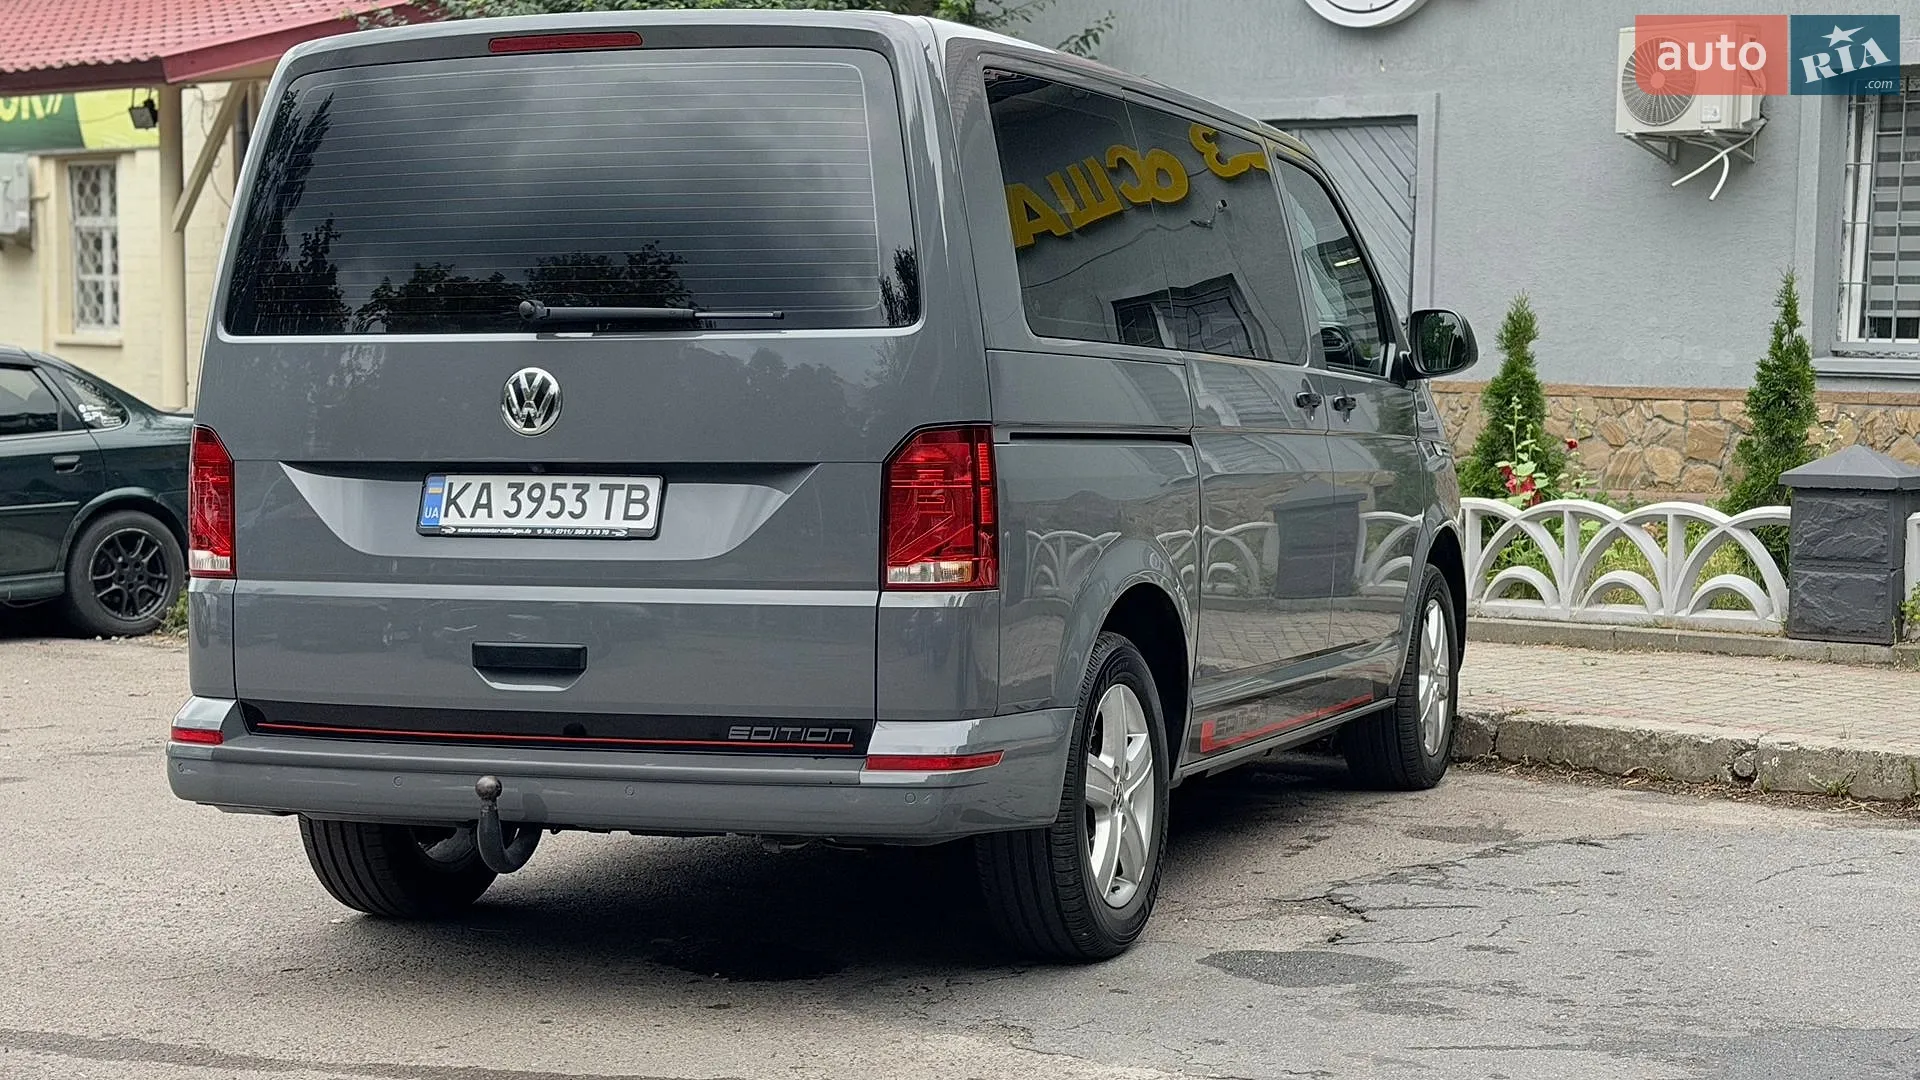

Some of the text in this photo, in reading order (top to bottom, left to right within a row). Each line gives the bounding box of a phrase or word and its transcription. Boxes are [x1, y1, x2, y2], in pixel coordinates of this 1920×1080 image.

[443, 482, 651, 521] KA 3953 TB
[424, 507, 439, 519] UA
[727, 725, 853, 743] EDITION
